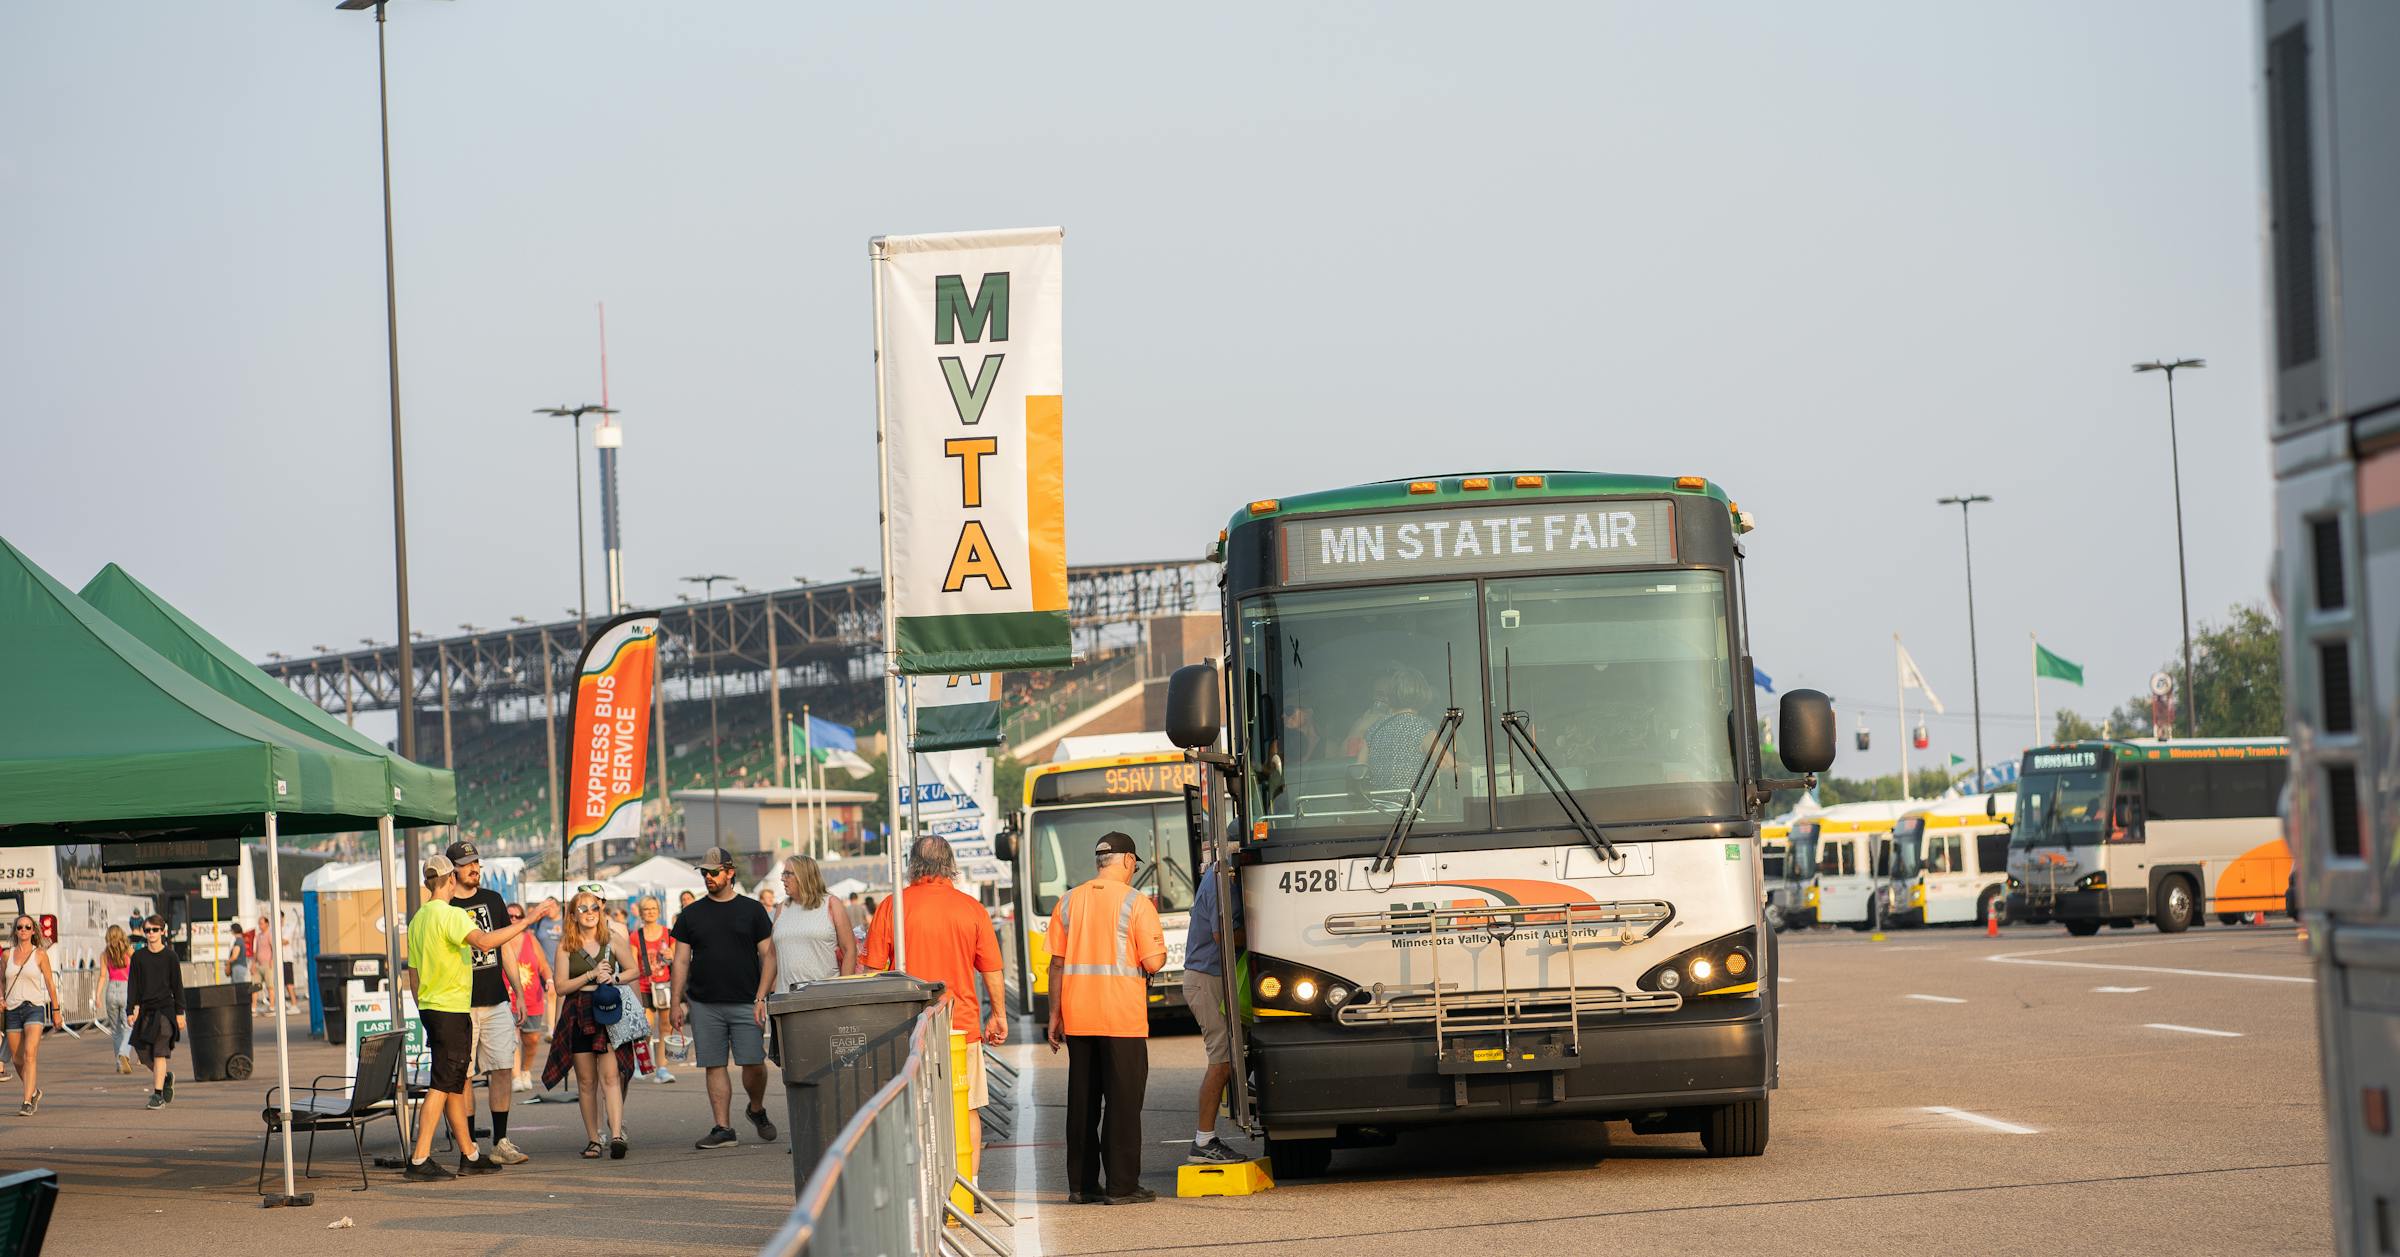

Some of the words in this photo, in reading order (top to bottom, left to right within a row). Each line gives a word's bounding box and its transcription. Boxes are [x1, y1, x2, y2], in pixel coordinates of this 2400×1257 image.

[934, 271, 1012, 593] MVTA
[1320, 525, 1385, 564] MN
[1397, 516, 1533, 560] STATE
[1543, 511, 1638, 551] FAIR
[595, 675, 616, 717] BUS
[612, 706, 636, 795] SERVICE
[586, 723, 611, 818] EXPRESS
[1105, 766, 1154, 794] 95AV
[1160, 764, 1196, 791] P&R
[1278, 869, 1337, 893] 4528
[1391, 937, 1455, 949] Minnesota
[1457, 934, 1494, 945] Valley
[1509, 930, 1540, 942] ansit
[1542, 927, 1599, 940] Authority
[354, 1003, 382, 1013] MVTA
[363, 1021, 392, 1032] LAST
[831, 1036, 866, 1047] EAGLE
